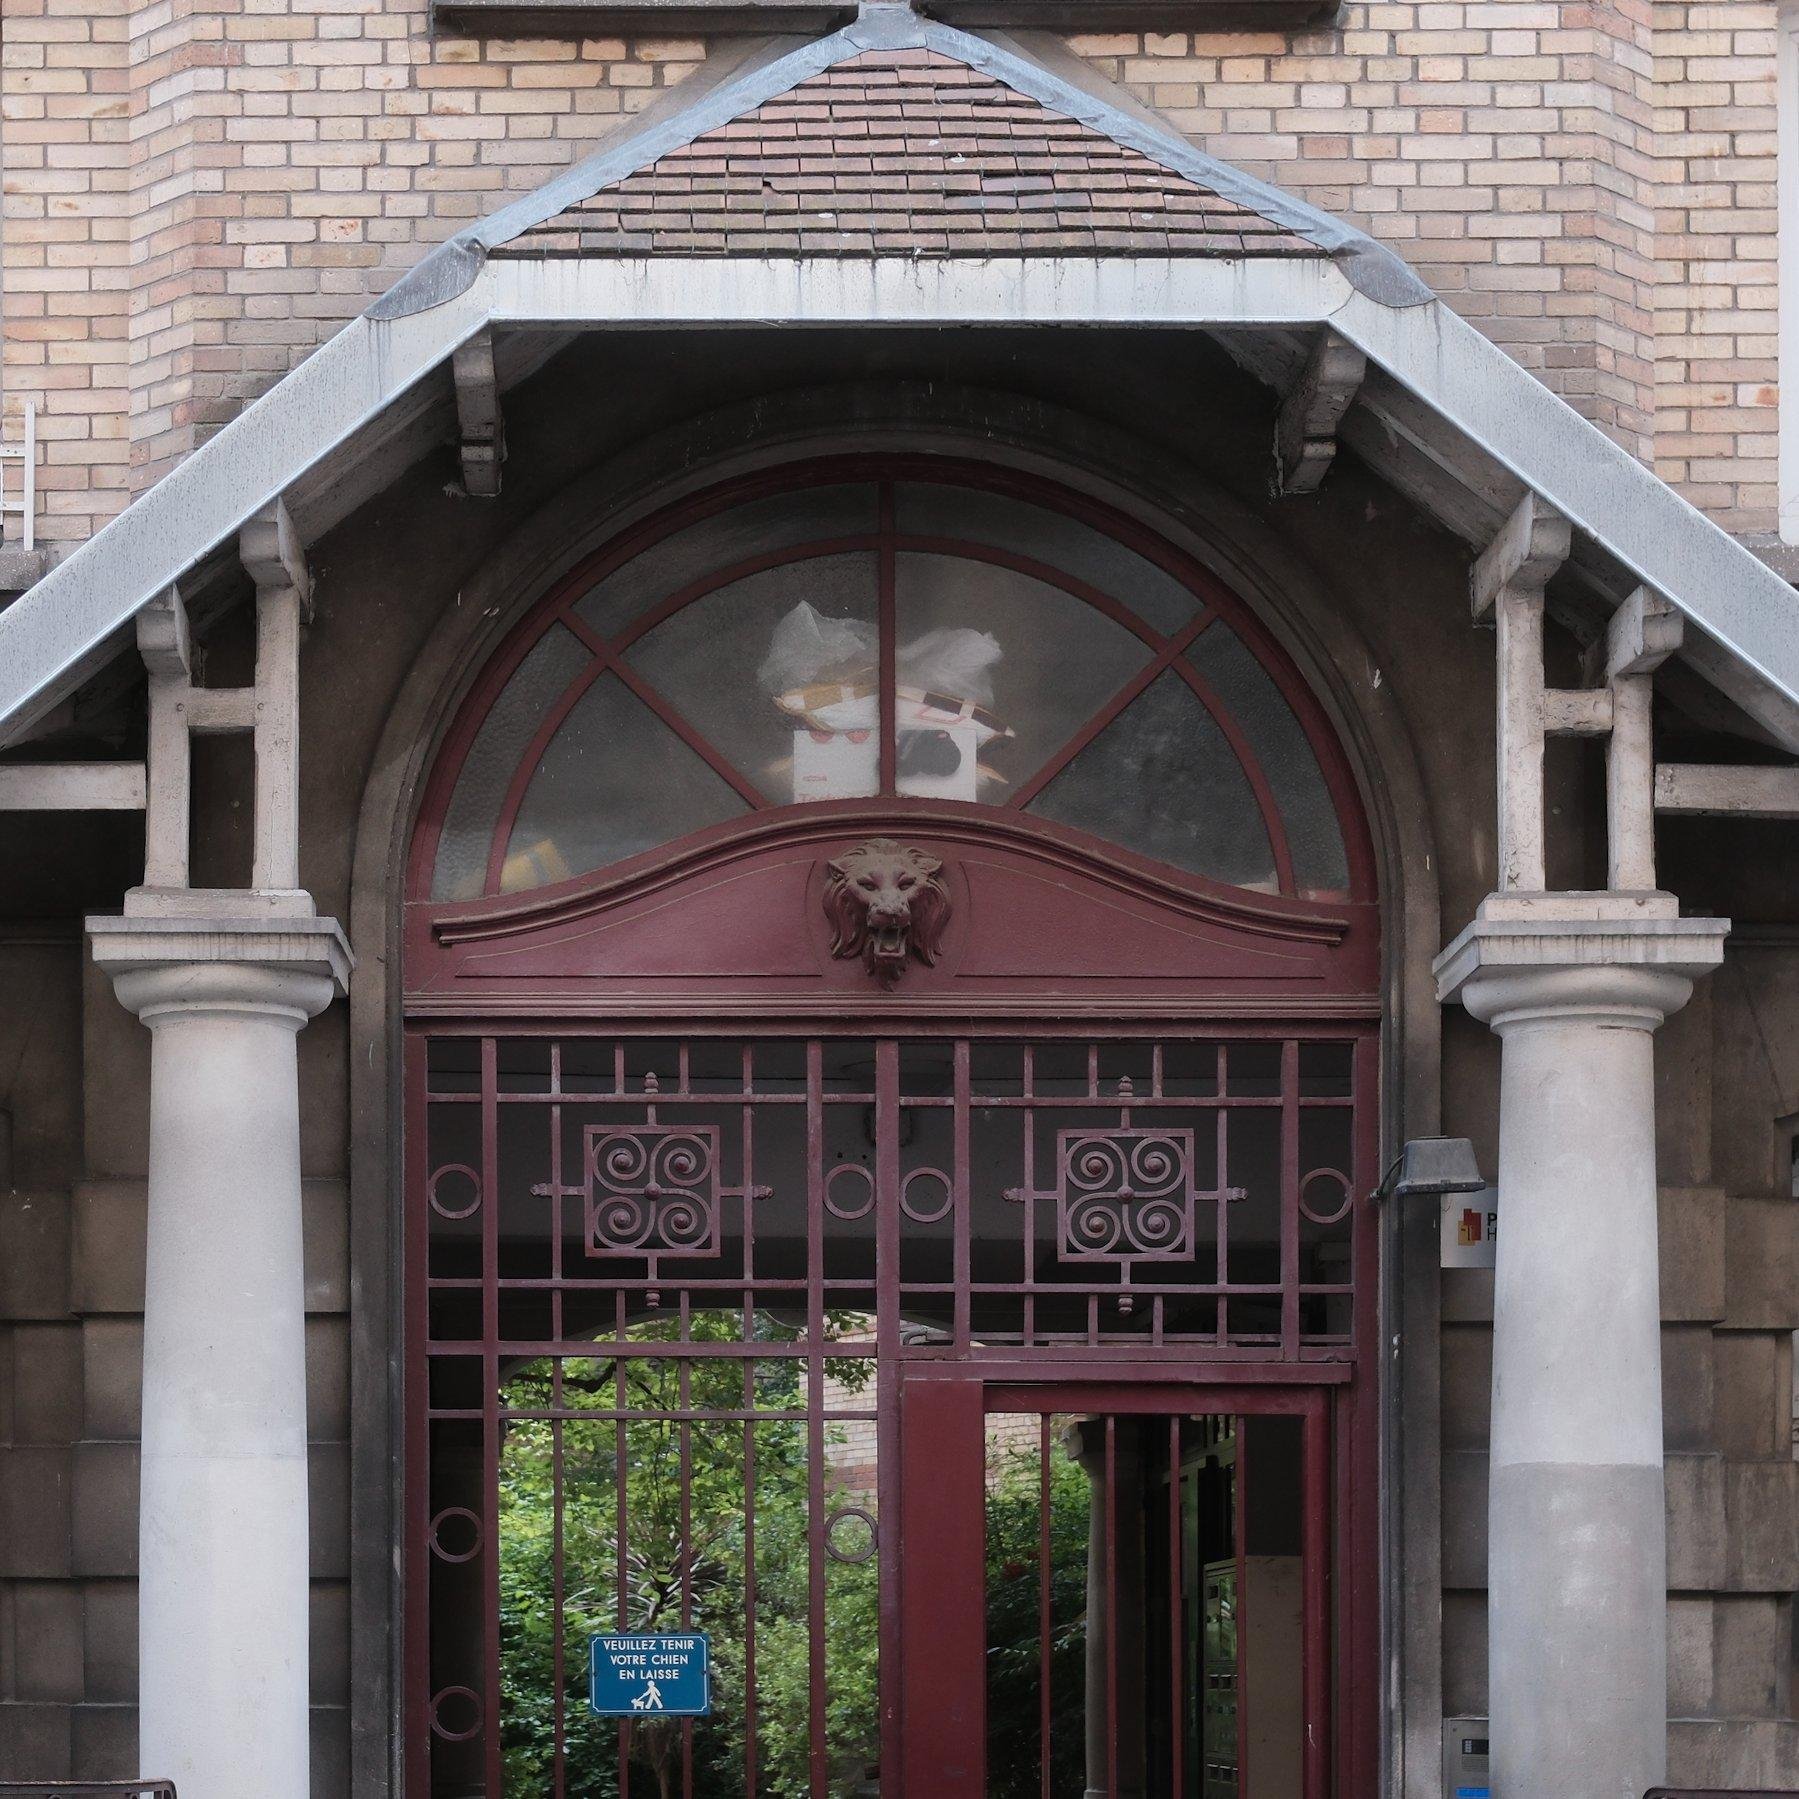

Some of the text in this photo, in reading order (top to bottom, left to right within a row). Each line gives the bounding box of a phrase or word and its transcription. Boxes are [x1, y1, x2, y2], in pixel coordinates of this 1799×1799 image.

[603, 1639, 695, 1650] VEUILLEZ TENIR
[610, 1654, 689, 1665] VOTRE CHIEN
[619, 1669, 680, 1680] EN LAISSE
